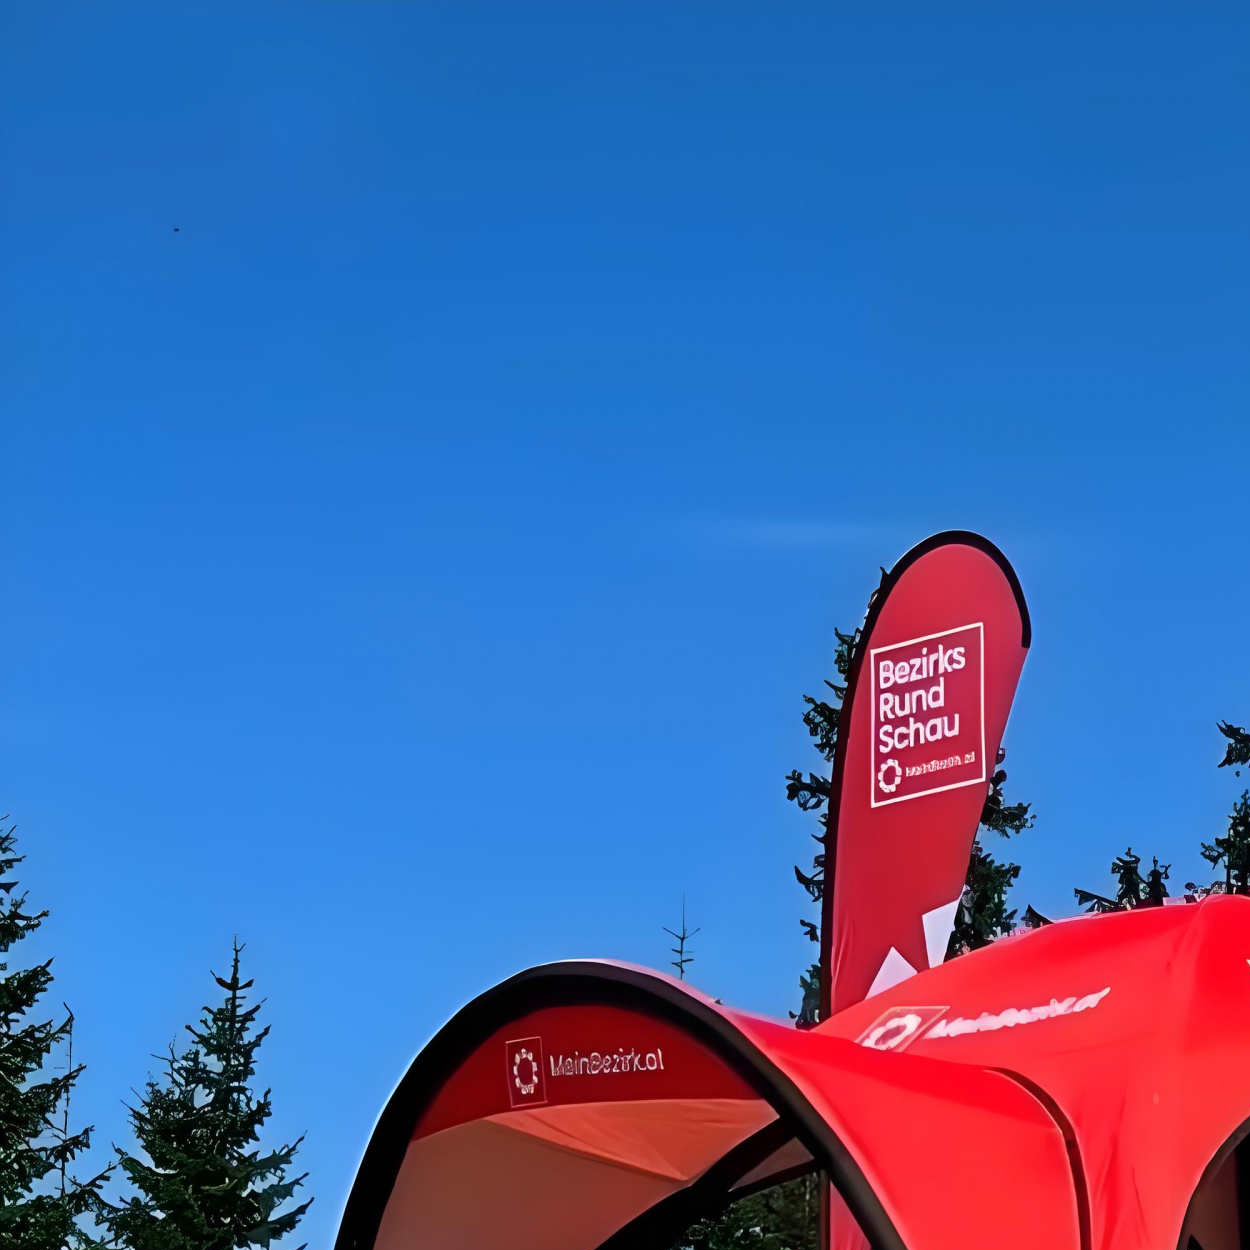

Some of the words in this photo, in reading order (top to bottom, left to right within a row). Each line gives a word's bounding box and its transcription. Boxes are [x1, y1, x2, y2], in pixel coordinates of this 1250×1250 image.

[879, 644, 966, 689] Bezirks
[879, 677, 945, 722] Rund
[879, 713, 960, 753] Schau
